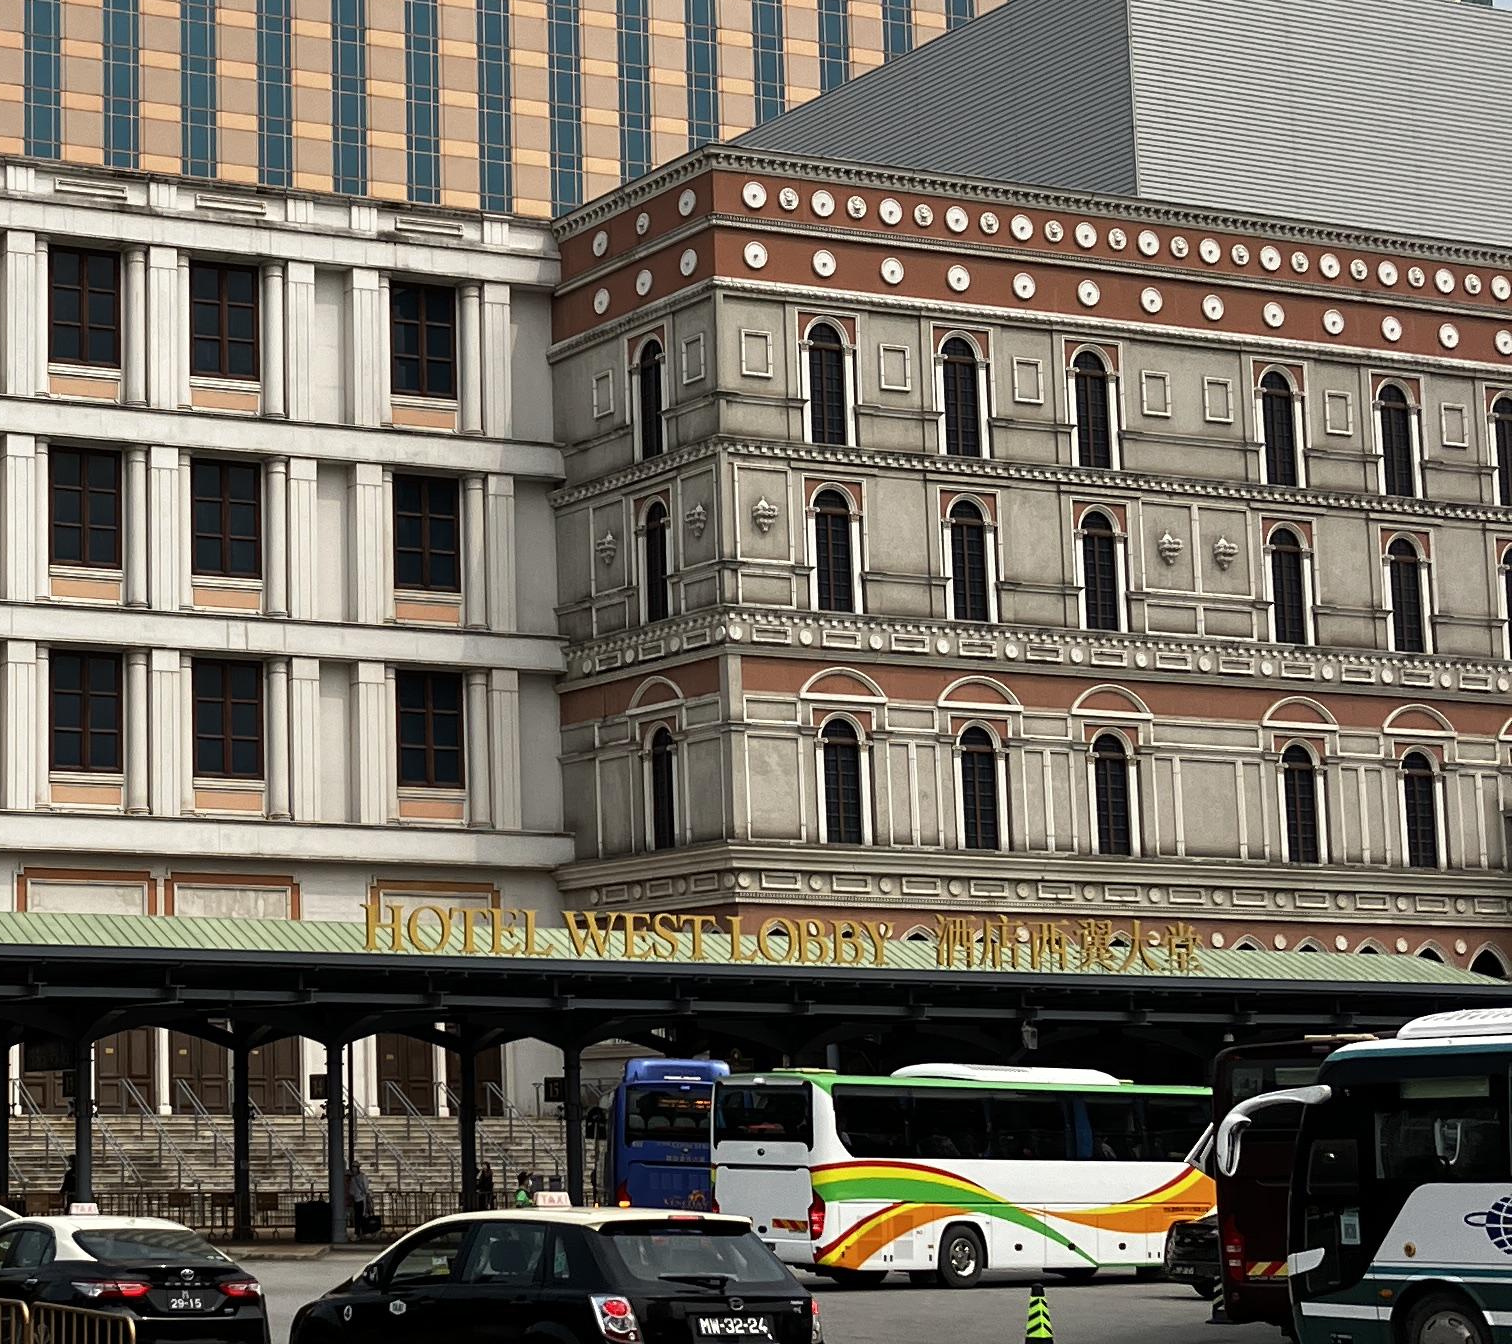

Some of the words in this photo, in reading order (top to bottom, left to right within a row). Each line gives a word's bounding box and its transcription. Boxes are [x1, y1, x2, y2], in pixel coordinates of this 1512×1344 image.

[360, 903, 553, 957] HOTEL
[562, 910, 717, 962] WEST
[725, 915, 896, 968] LOBBY
[933, 914, 1205, 972] 酒店西翼大堂
[541, 1194, 569, 1205] TAXI
[170, 1298, 202, 1308] 29-15
[699, 1317, 768, 1334] MW-32-24
